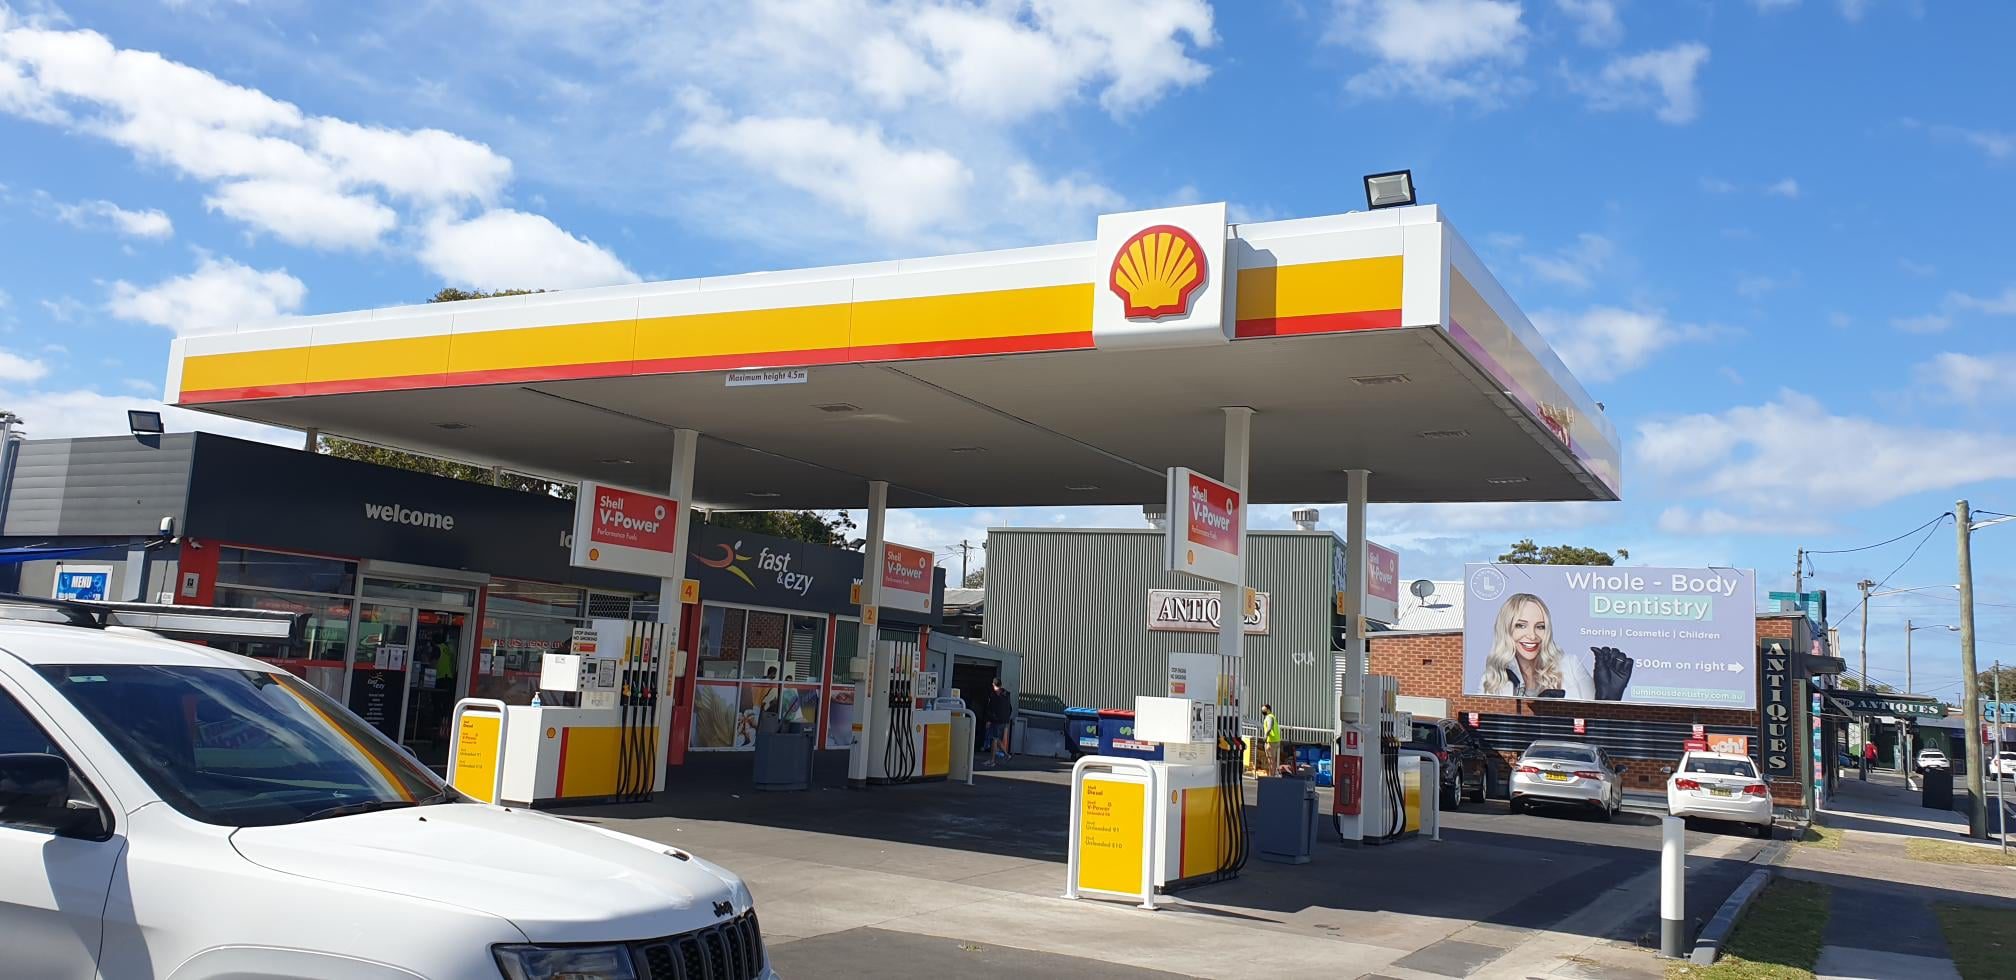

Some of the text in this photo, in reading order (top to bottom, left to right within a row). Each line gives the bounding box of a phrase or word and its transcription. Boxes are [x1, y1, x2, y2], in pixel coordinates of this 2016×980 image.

[729, 370, 805, 382] Maximum height 4.5m
[1192, 485, 1208, 503] Shell
[599, 495, 624, 510] Shell
[365, 503, 455, 531] welcome
[599, 508, 660, 534] V-Power
[1192, 501, 1230, 532] V-Power
[757, 547, 792, 573] fast
[887, 550, 902, 562] Shell
[887, 560, 922, 579] V-Power
[71, 575, 92, 588] MENU
[1565, 572, 1645, 592] Whole
[1671, 573, 1738, 597] Body
[684, 585, 692, 598] 4
[867, 609, 873, 620] 2
[1157, 597, 1262, 628] ANTIQS
[1593, 595, 1709, 620] Dentistry
[1580, 627, 1617, 637] Snoring
[1625, 629, 1671, 639] Cosmetic
[1679, 630, 1720, 640] Children
[1635, 658, 1726, 673] 500m on right
[1632, 687, 1744, 700] luminousdentistry.com.au
[1766, 642, 1790, 770] ANTIQUES
[1858, 699, 1939, 714] ANTIQUES
[1087, 804, 1110, 812] V-Power
